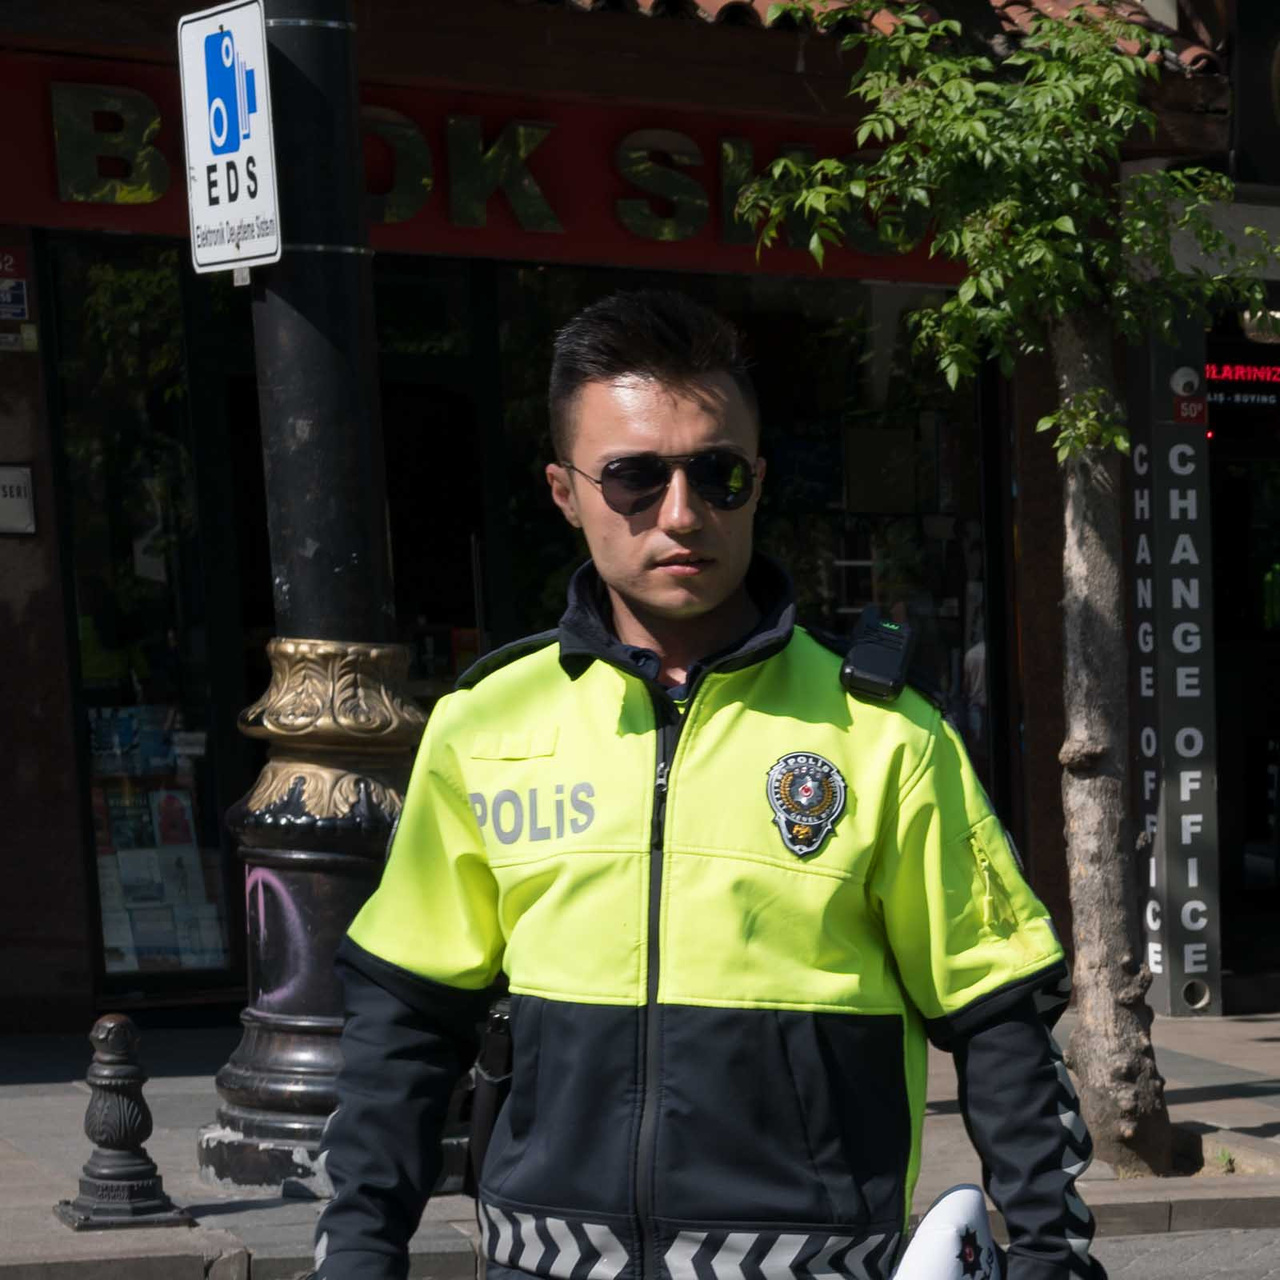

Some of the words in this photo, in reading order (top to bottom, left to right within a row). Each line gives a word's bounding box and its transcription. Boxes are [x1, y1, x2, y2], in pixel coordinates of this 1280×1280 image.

[206, 156, 258, 206] EDS
[1133, 444, 1155, 698] CHANGE
[1168, 443, 1201, 698] CHANGE
[1175, 726, 1209, 975] OFFICE
